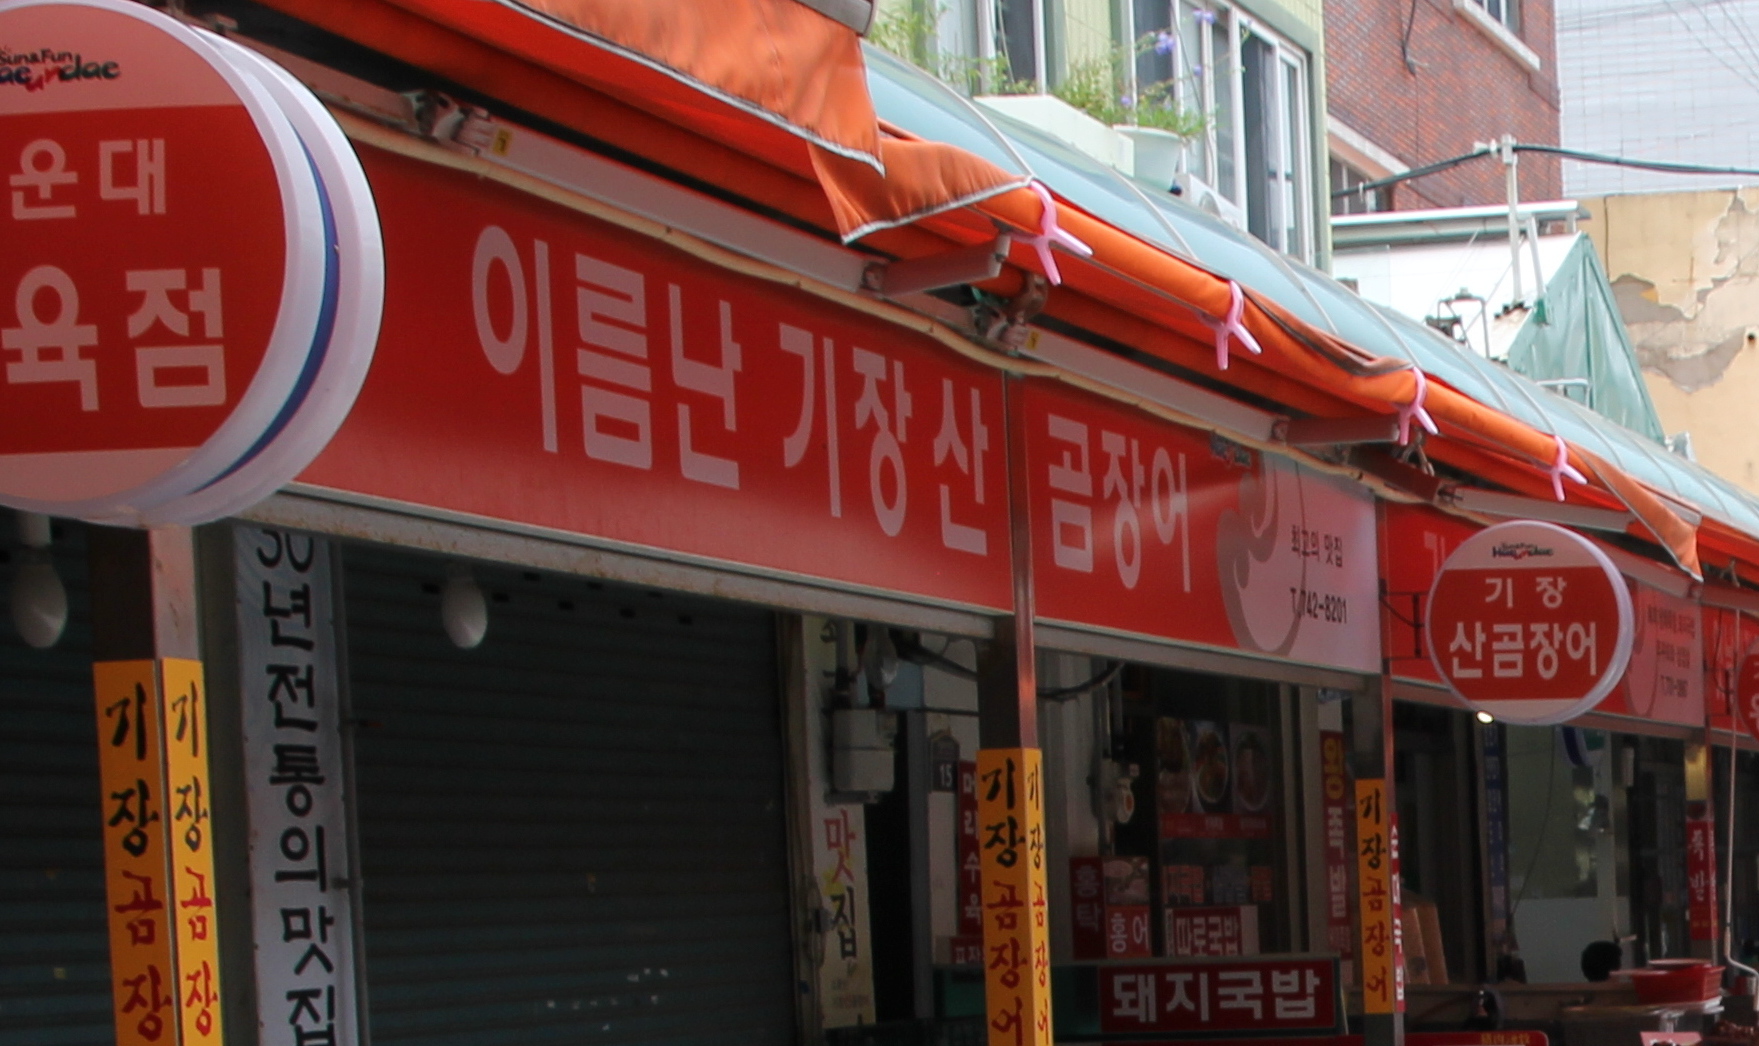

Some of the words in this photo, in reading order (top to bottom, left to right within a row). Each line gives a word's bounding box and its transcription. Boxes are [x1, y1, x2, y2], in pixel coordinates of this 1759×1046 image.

[2, 267, 229, 412] 육점
[471, 224, 741, 492] 이름난
[1449, 620, 1598, 681] 산곰장어
[823, 808, 857, 960] 맛집
[1111, 968, 1321, 1023] 돼지국밥
